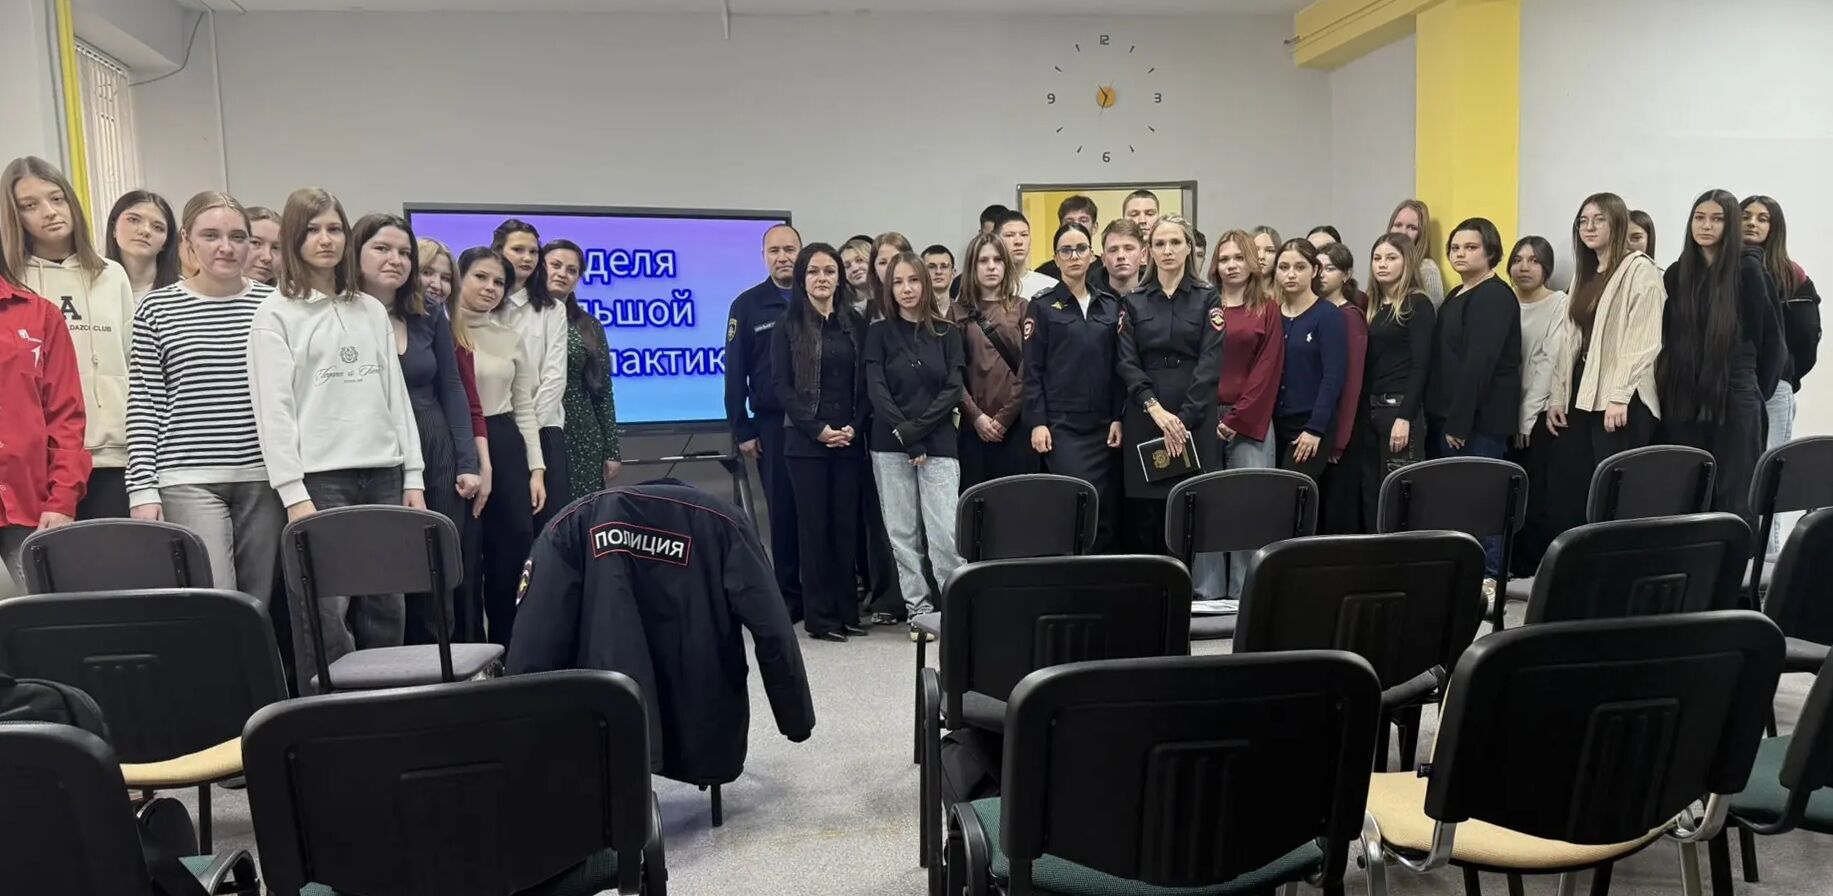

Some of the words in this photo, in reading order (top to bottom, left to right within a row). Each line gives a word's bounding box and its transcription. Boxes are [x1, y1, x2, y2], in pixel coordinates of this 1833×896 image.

[1099, 34, 1110, 46] 12
[1047, 93, 1056, 104] 9
[1153, 92, 1162, 104] 3
[1102, 151, 1111, 163] 6
[584, 250, 675, 283] деля
[60, 295, 83, 321] A
[577, 291, 694, 327] ьшой
[609, 350, 726, 375] актик
[594, 528, 685, 559] ПОЛИЦИЯ
